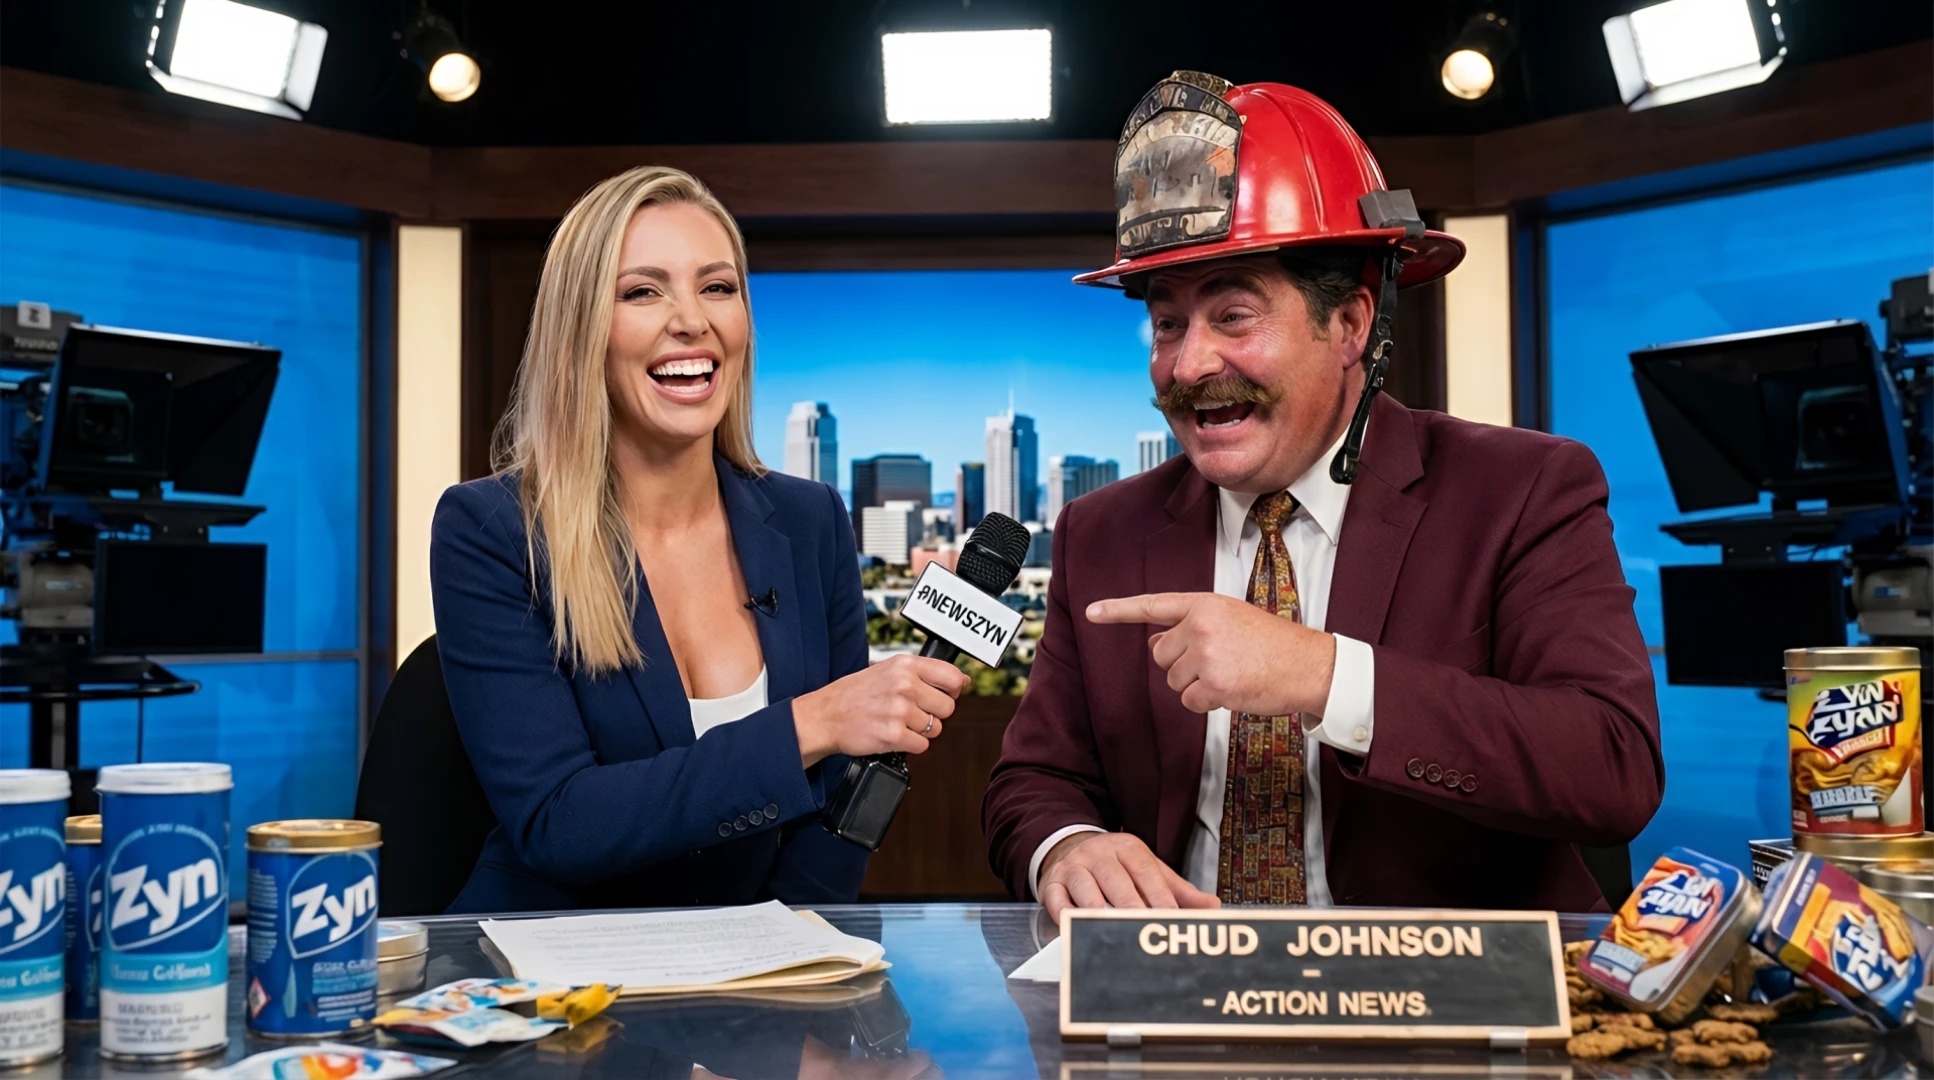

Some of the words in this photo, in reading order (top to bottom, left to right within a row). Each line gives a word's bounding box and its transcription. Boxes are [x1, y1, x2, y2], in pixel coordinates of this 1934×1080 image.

[111, 857, 219, 936] Zyn
[291, 874, 377, 943] Zyn
[1138, 921, 1260, 957] CHUD
[1286, 924, 1484, 958] JOHNSON
[1221, 989, 1329, 1017] ACTION
[1337, 990, 1428, 1018] NEWS
